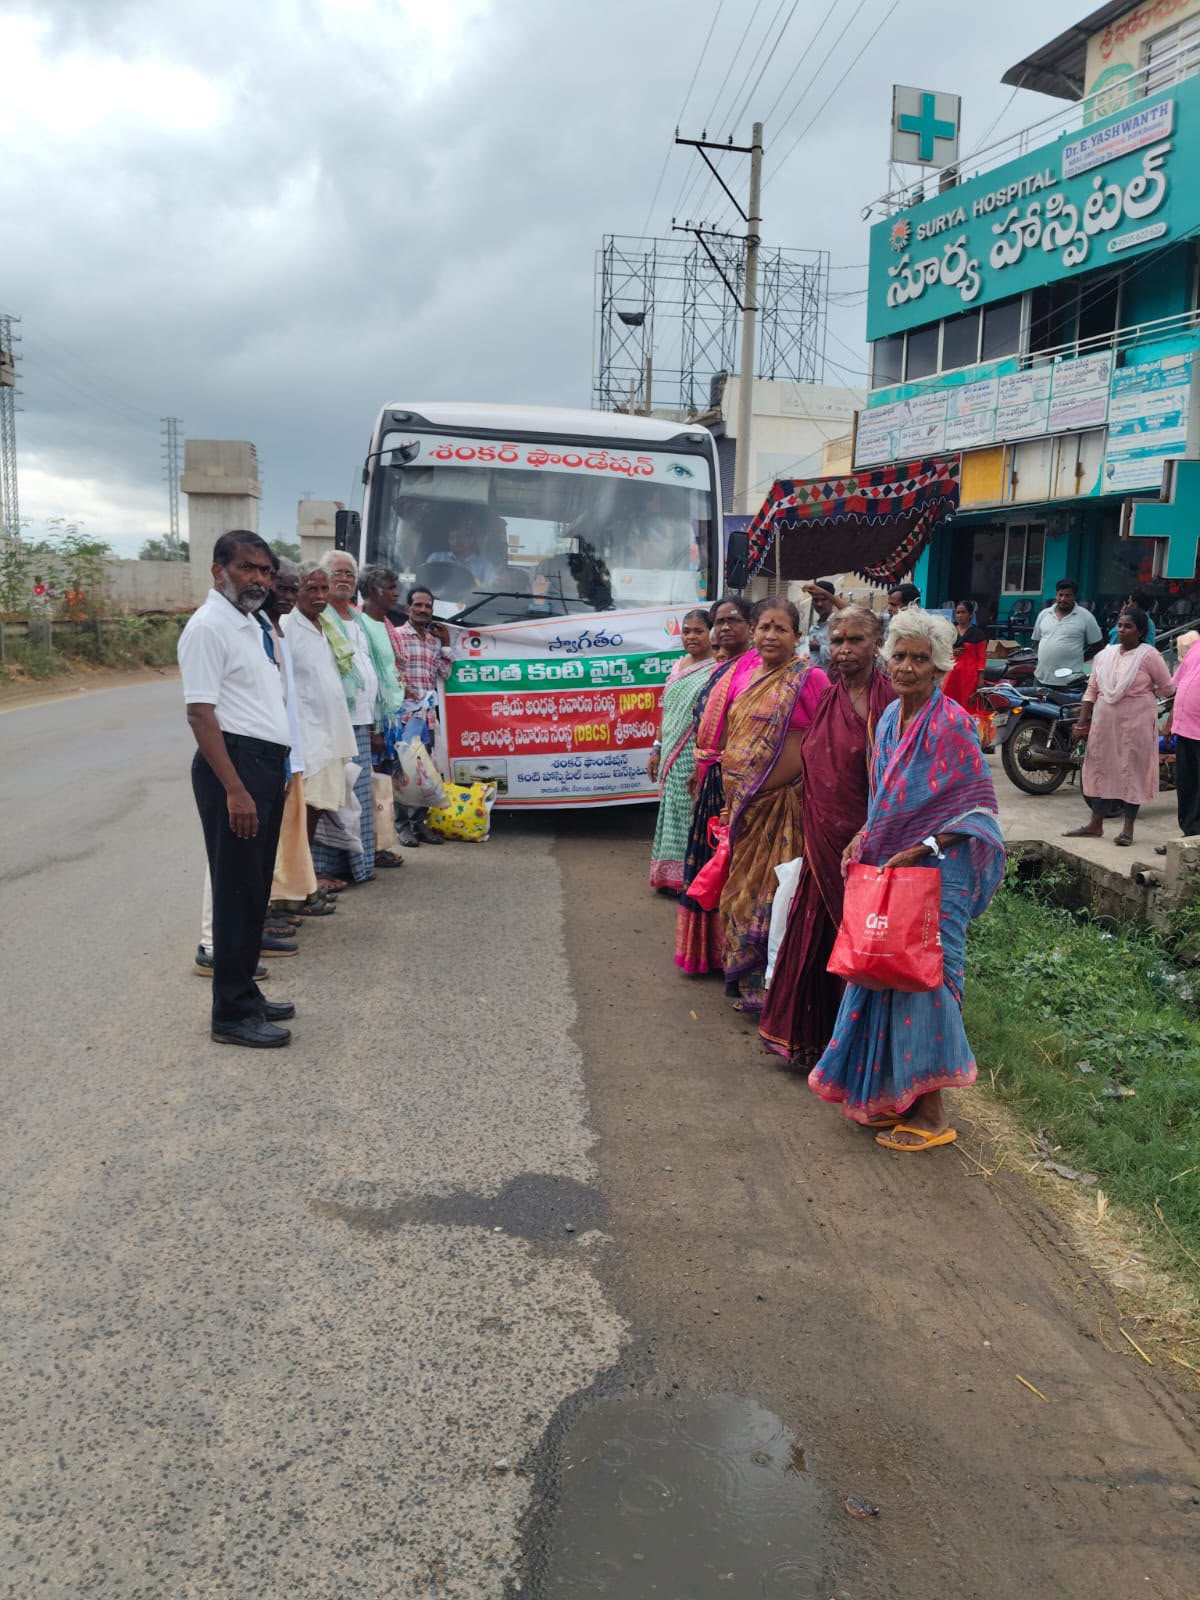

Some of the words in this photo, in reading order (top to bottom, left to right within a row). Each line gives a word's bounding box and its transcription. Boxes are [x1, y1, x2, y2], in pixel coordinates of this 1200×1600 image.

[1090, 102, 1169, 147] YASHWANTH
[916, 207, 967, 241] SURYA
[973, 168, 1057, 217] HOSPITAL
[887, 235, 981, 308] సూర్య
[989, 142, 1172, 268] హాస్పిటల్
[428, 444, 520, 463] శంకర్
[526, 448, 655, 477] ఫౌండేషన్
[548, 629, 624, 653] స్వాగతం
[456, 662, 522, 683] ఉచిత
[527, 660, 584, 681] కంటి
[589, 658, 635, 684] వైద్య
[619, 692, 655, 715] (NPCB)
[574, 723, 610, 746] (DBCS)
